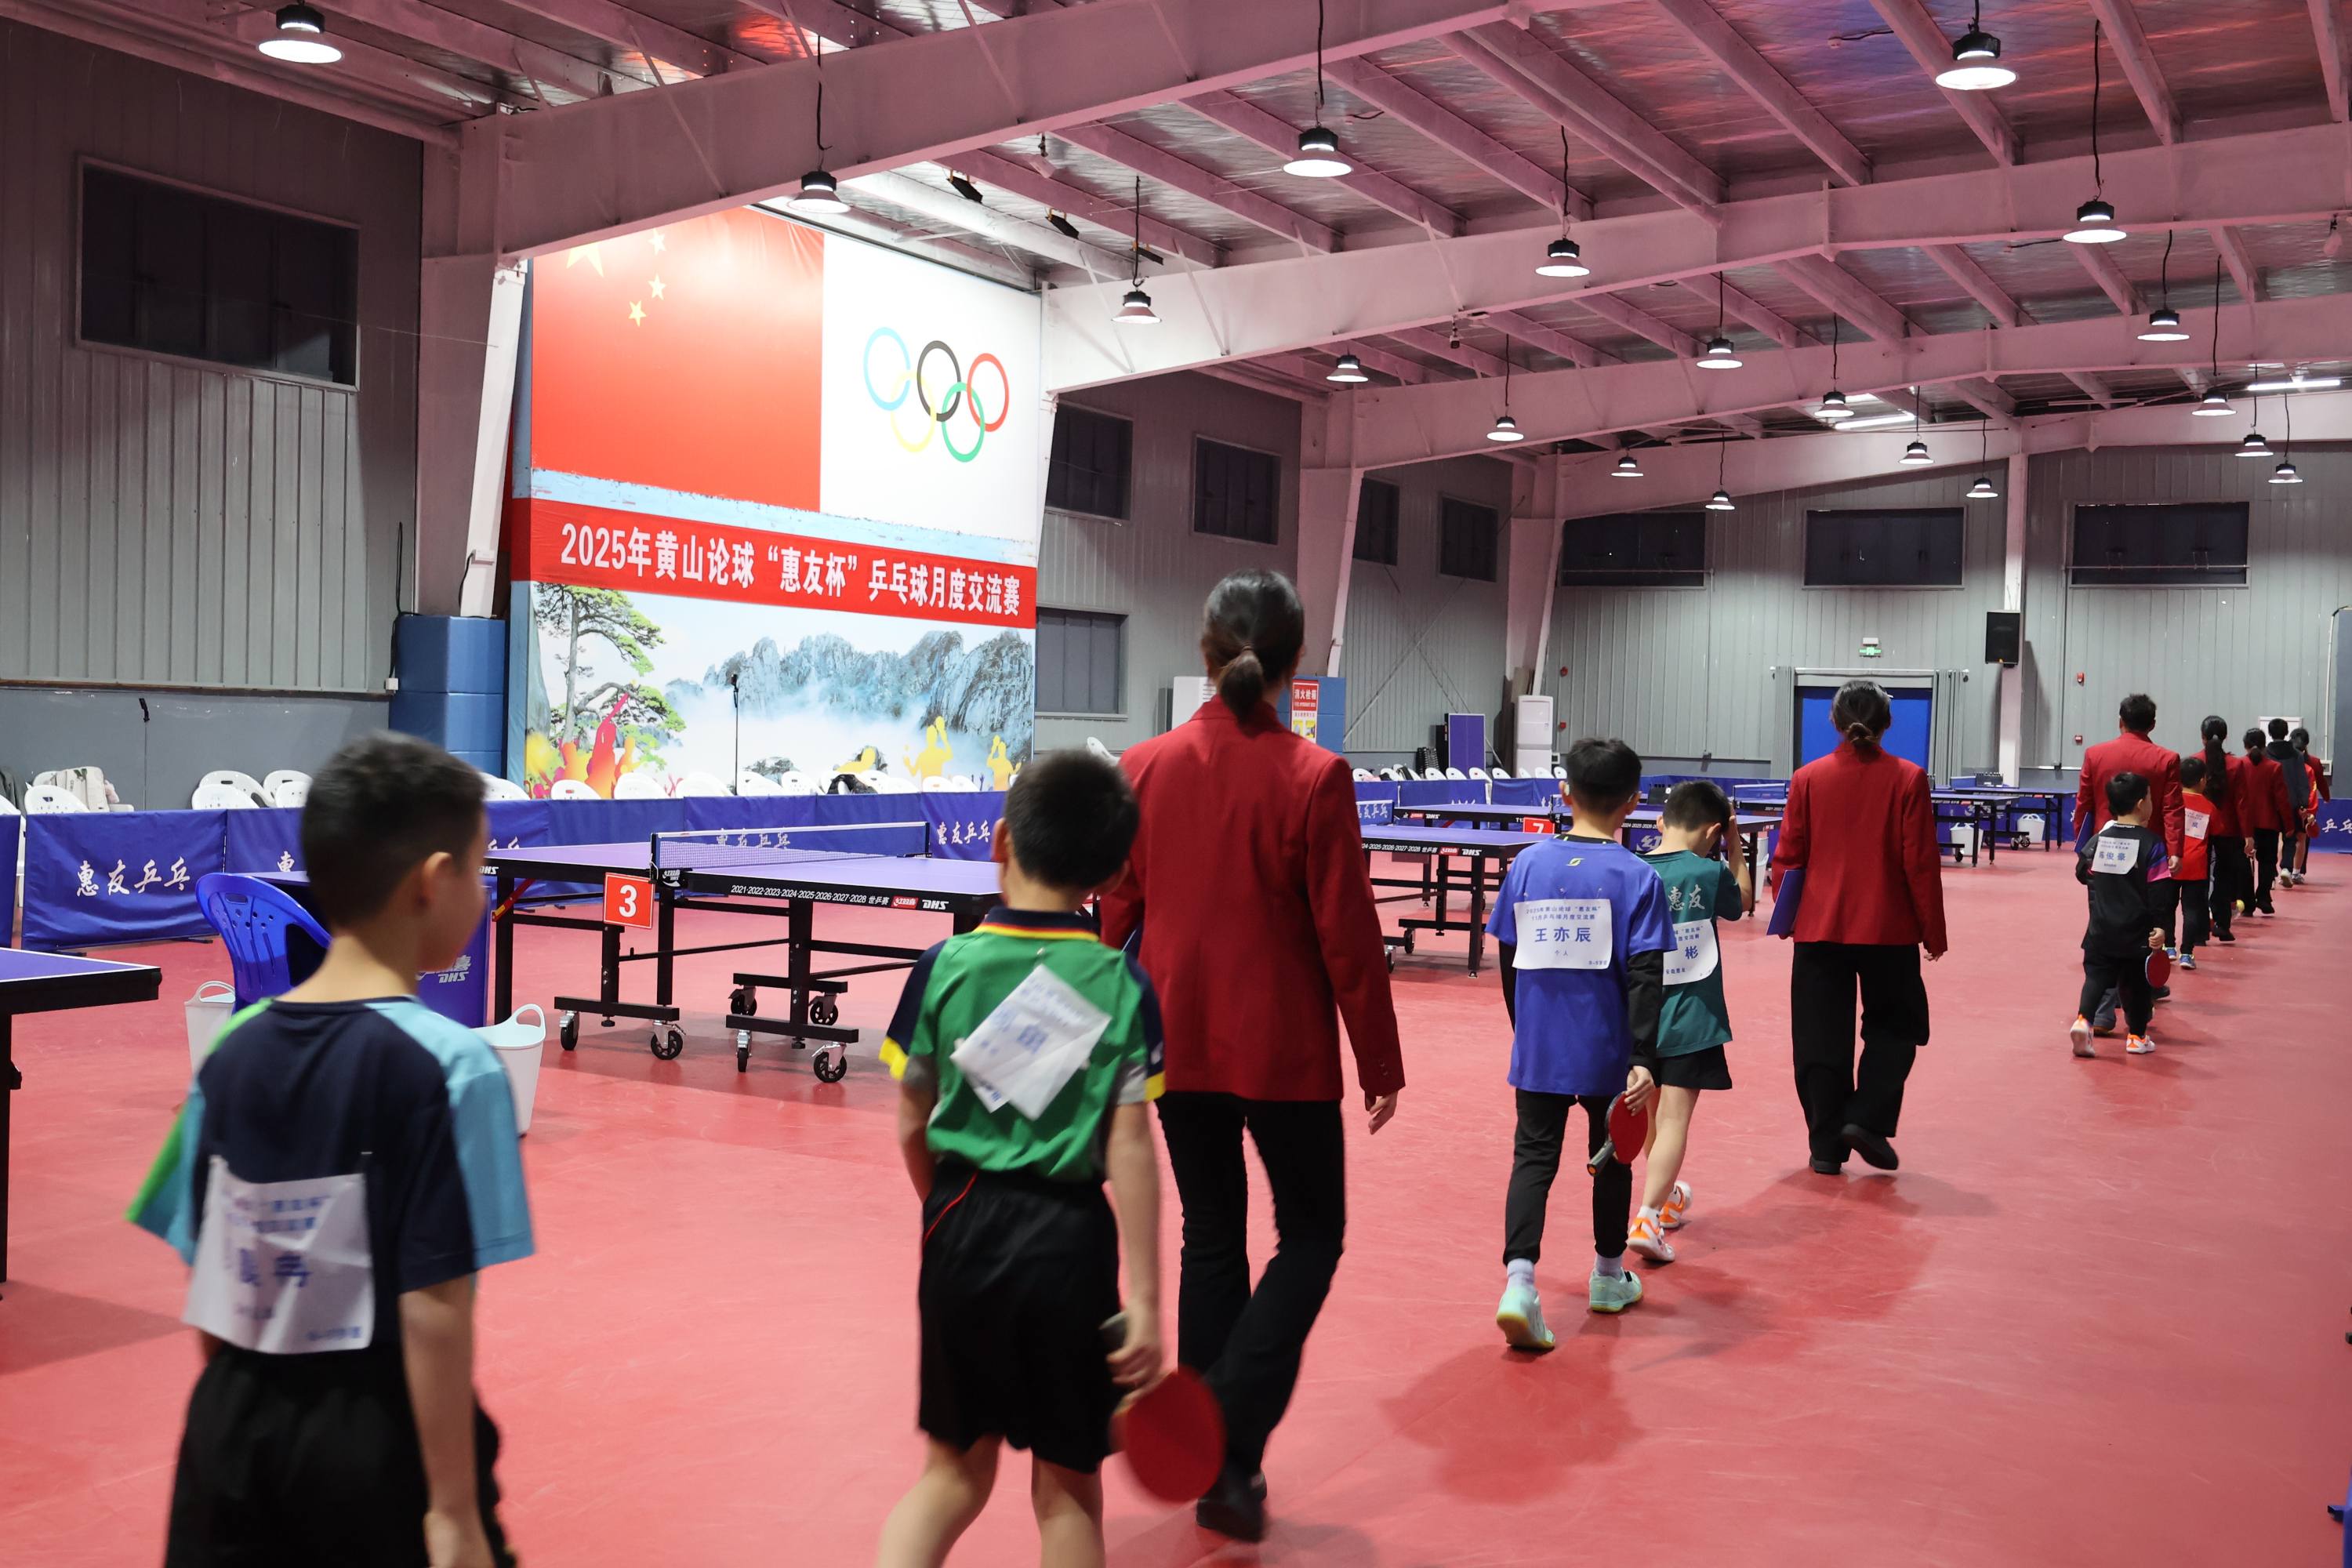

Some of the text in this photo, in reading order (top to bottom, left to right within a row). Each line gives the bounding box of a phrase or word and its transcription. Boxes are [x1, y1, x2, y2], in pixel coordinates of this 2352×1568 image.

[937, 820, 990, 845] 惠友乒乓
[77, 856, 191, 897] 惠友乒乓
[619, 884, 637, 917] 3
[868, 895, 890, 906] 世乒赛
[922, 899, 949, 910] DHS
[1668, 884, 1705, 911] 惠友
[1534, 926, 1592, 942] 王亦辰
[437, 971, 470, 984] DHS
